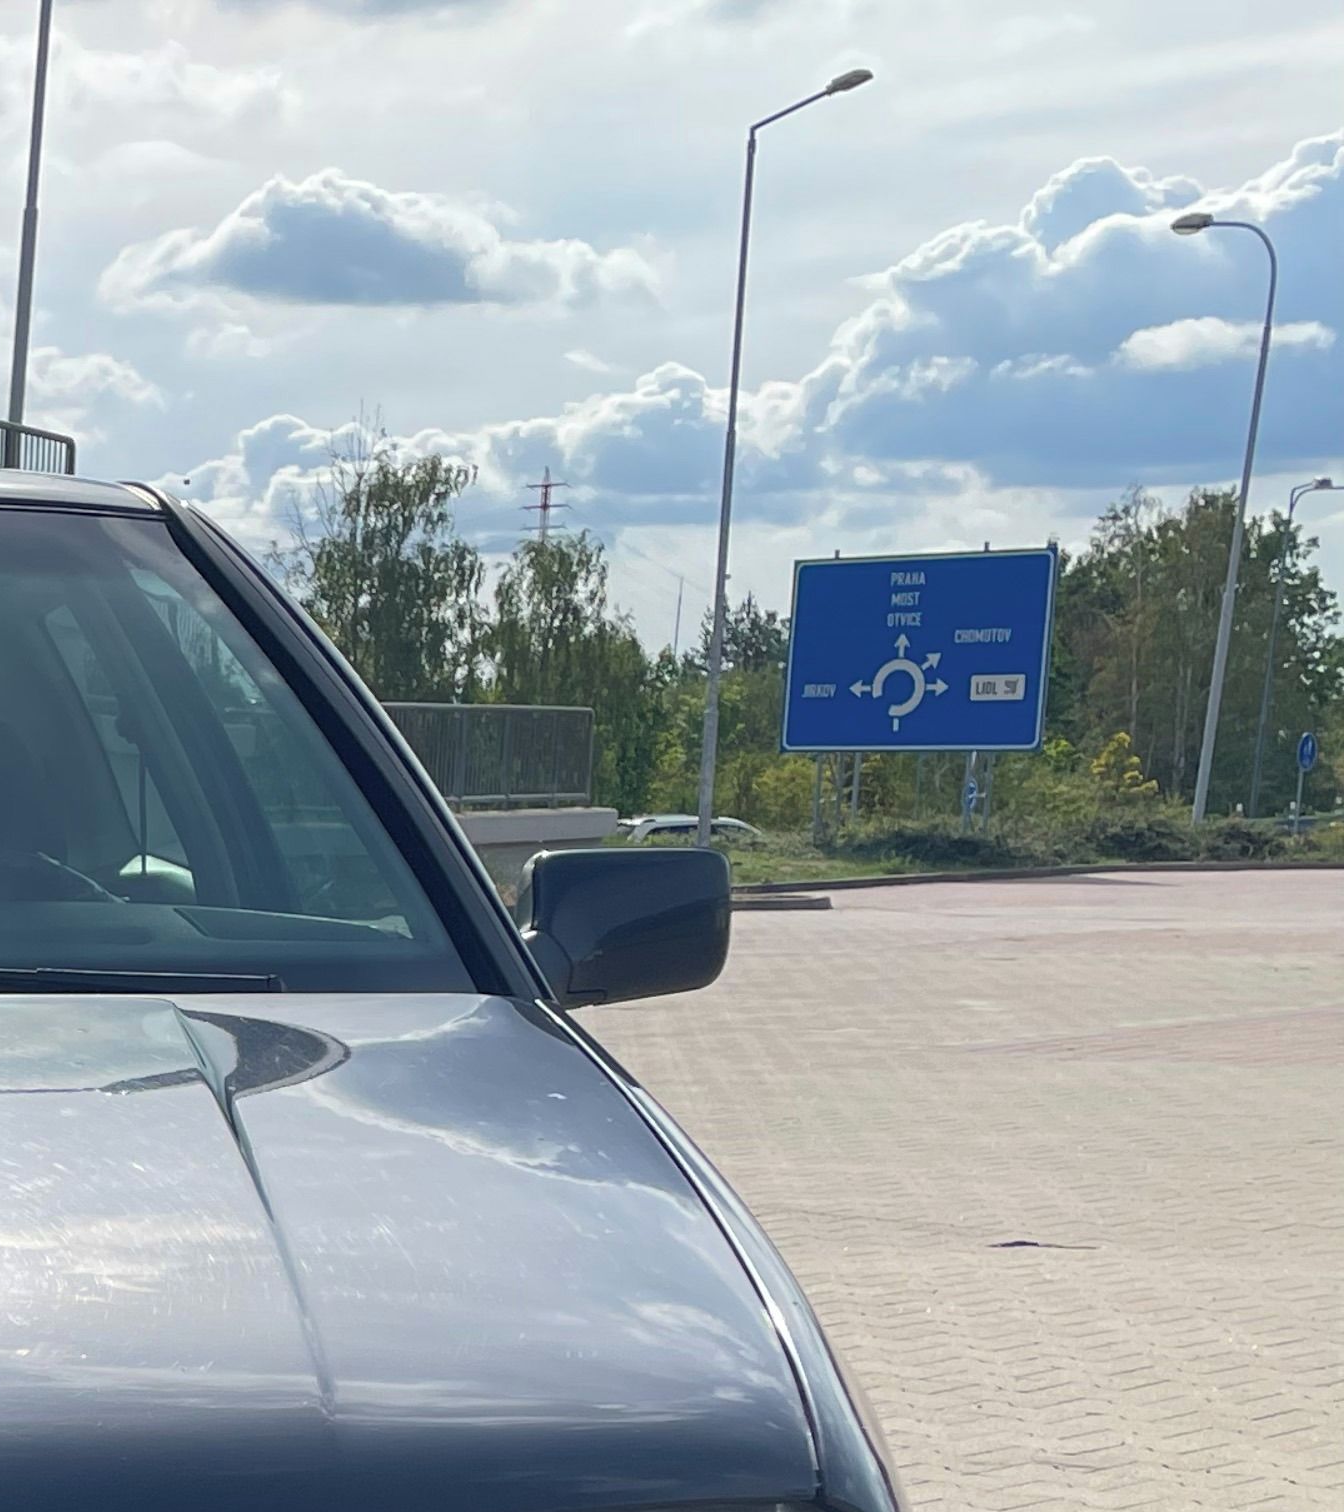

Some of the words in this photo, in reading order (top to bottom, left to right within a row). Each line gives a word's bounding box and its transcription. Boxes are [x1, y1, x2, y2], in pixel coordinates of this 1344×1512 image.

[890, 571, 926, 586] PRAHA
[891, 592, 920, 606] MOST
[954, 628, 1012, 643] CHOMUTOV
[976, 681, 998, 695] LIDL
